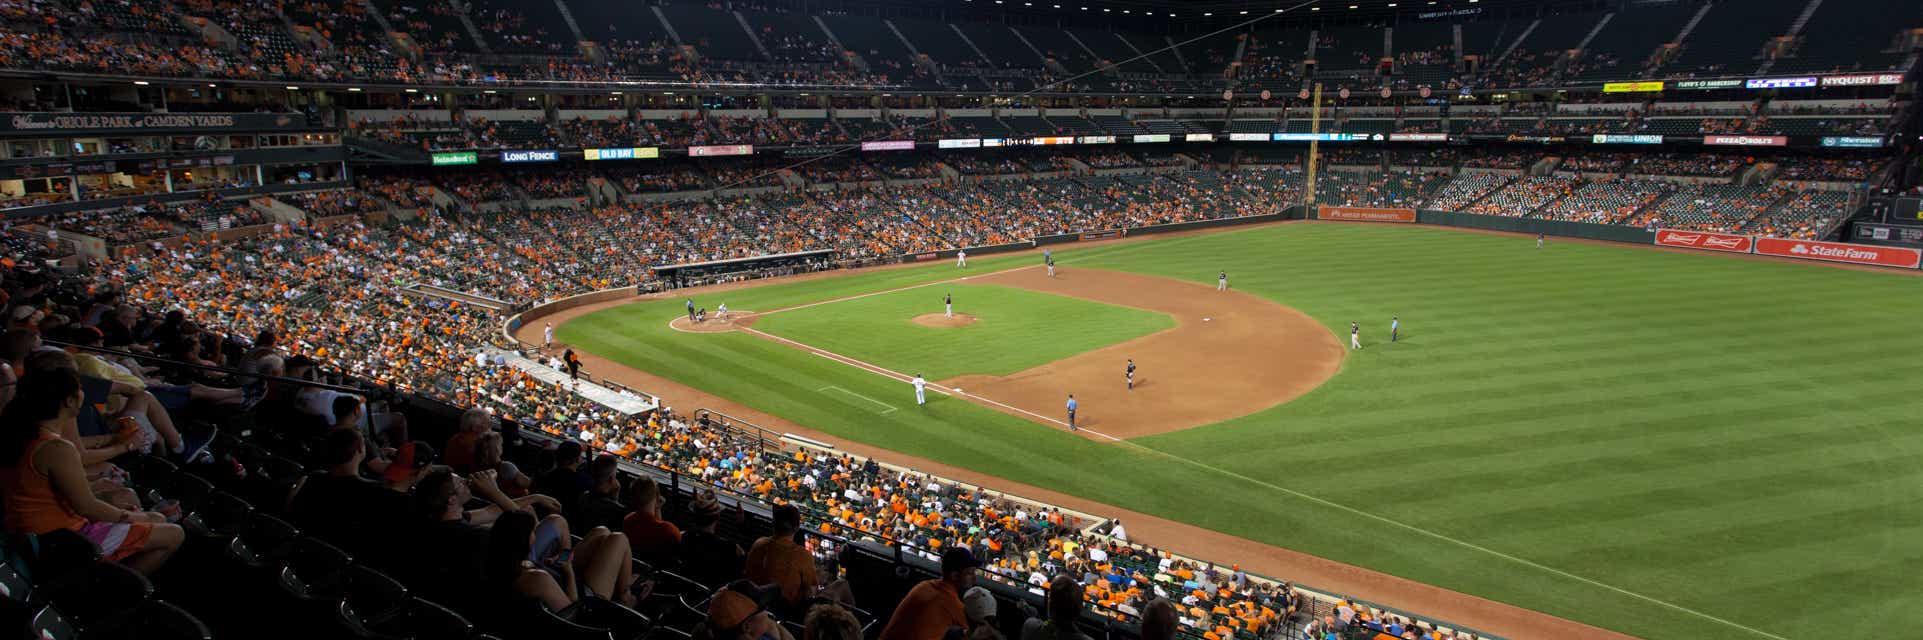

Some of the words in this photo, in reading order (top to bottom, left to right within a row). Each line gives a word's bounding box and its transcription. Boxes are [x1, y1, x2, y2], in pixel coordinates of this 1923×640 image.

[1822, 75, 1872, 86] NYQUIST
[55, 116, 100, 129] ORIOLE
[101, 116, 134, 128] PARK
[144, 115, 194, 128] CAMDEN
[195, 115, 233, 127] YARDS
[1633, 135, 1663, 144] UNION
[504, 152, 528, 161] LONG
[529, 151, 555, 160] FENCE
[601, 149, 617, 158] OLD
[617, 148, 632, 158] BAY
